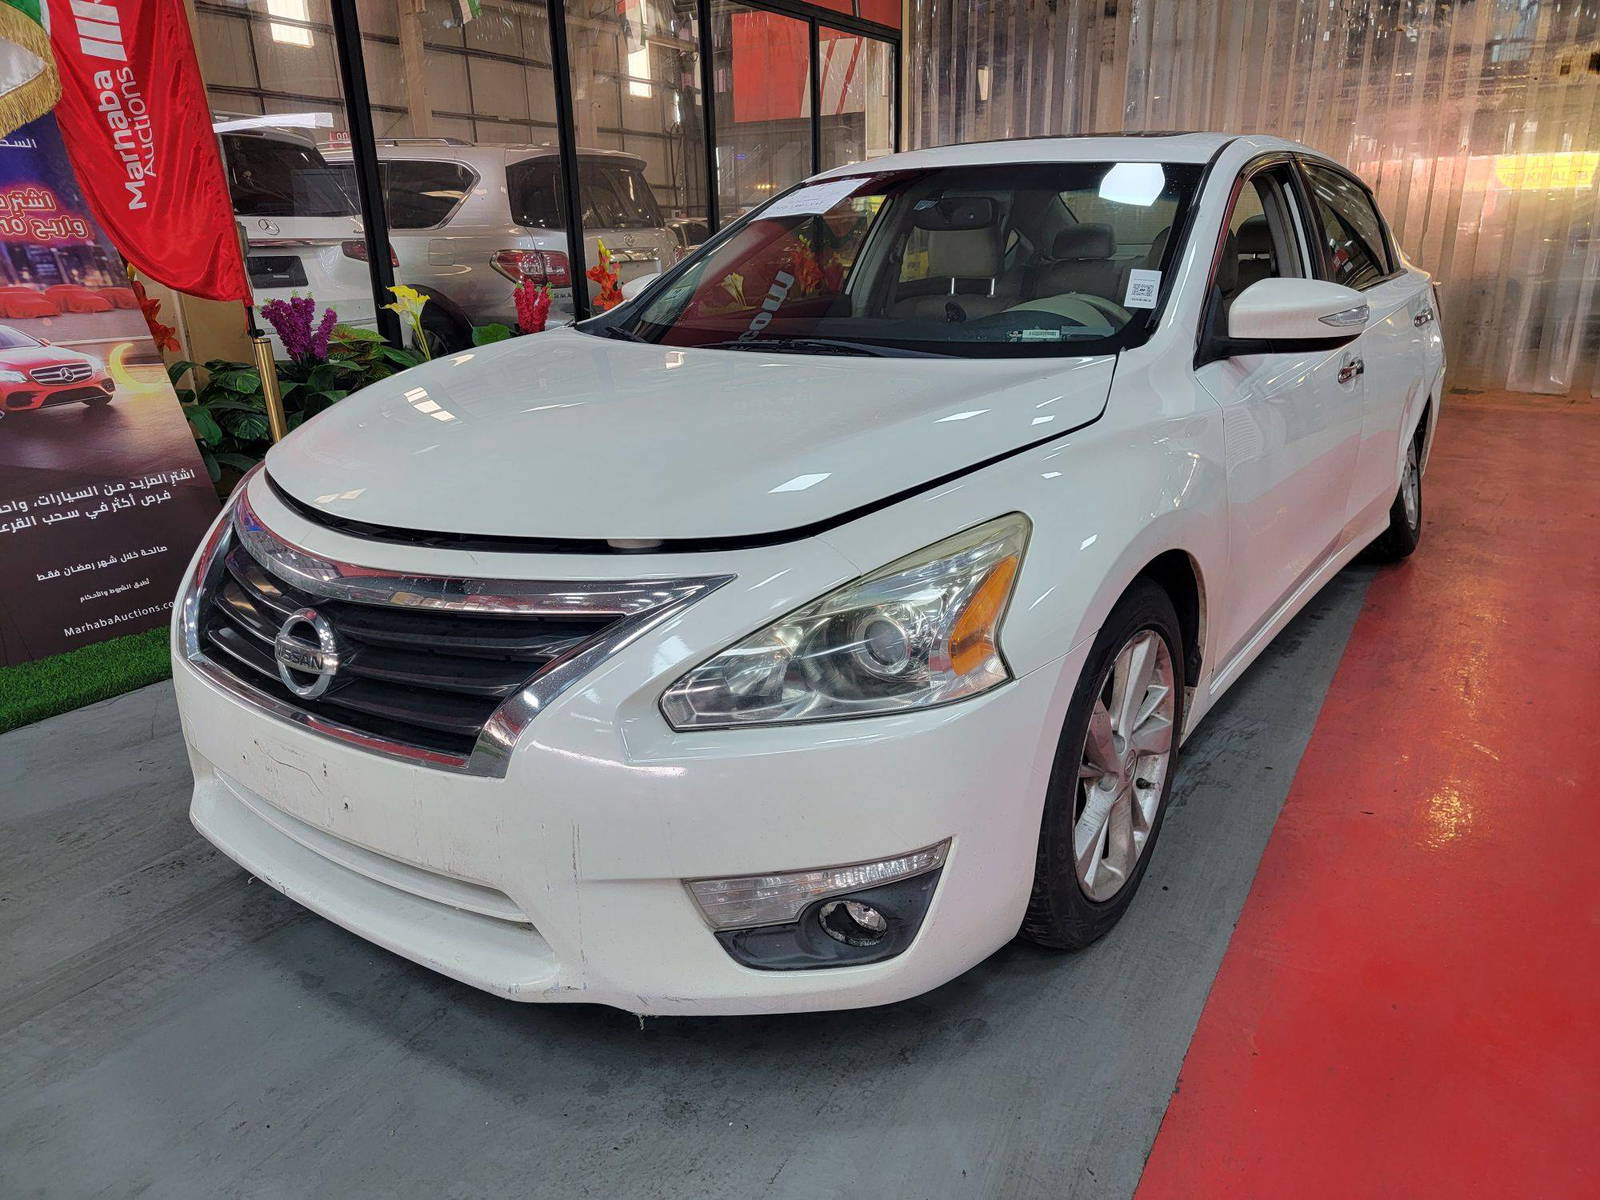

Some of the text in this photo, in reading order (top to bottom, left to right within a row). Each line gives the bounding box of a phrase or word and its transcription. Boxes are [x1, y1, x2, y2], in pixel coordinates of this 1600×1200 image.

[117, 66, 157, 177] Auctions
[94, 70, 147, 211] Marhaba
[33, 218, 85, 237] واربح
[103, 482, 125, 497] من
[131, 473, 167, 490] المزيد
[112, 493, 136, 512] أكثر
[141, 491, 171, 507] فرص
[43, 509, 80, 526] سحب
[86, 501, 109, 520] في
[36, 545, 168, 582] صالحة خلال شهر رمضان فقط
[64, 601, 174, 637] MarhabaAuctions.co
